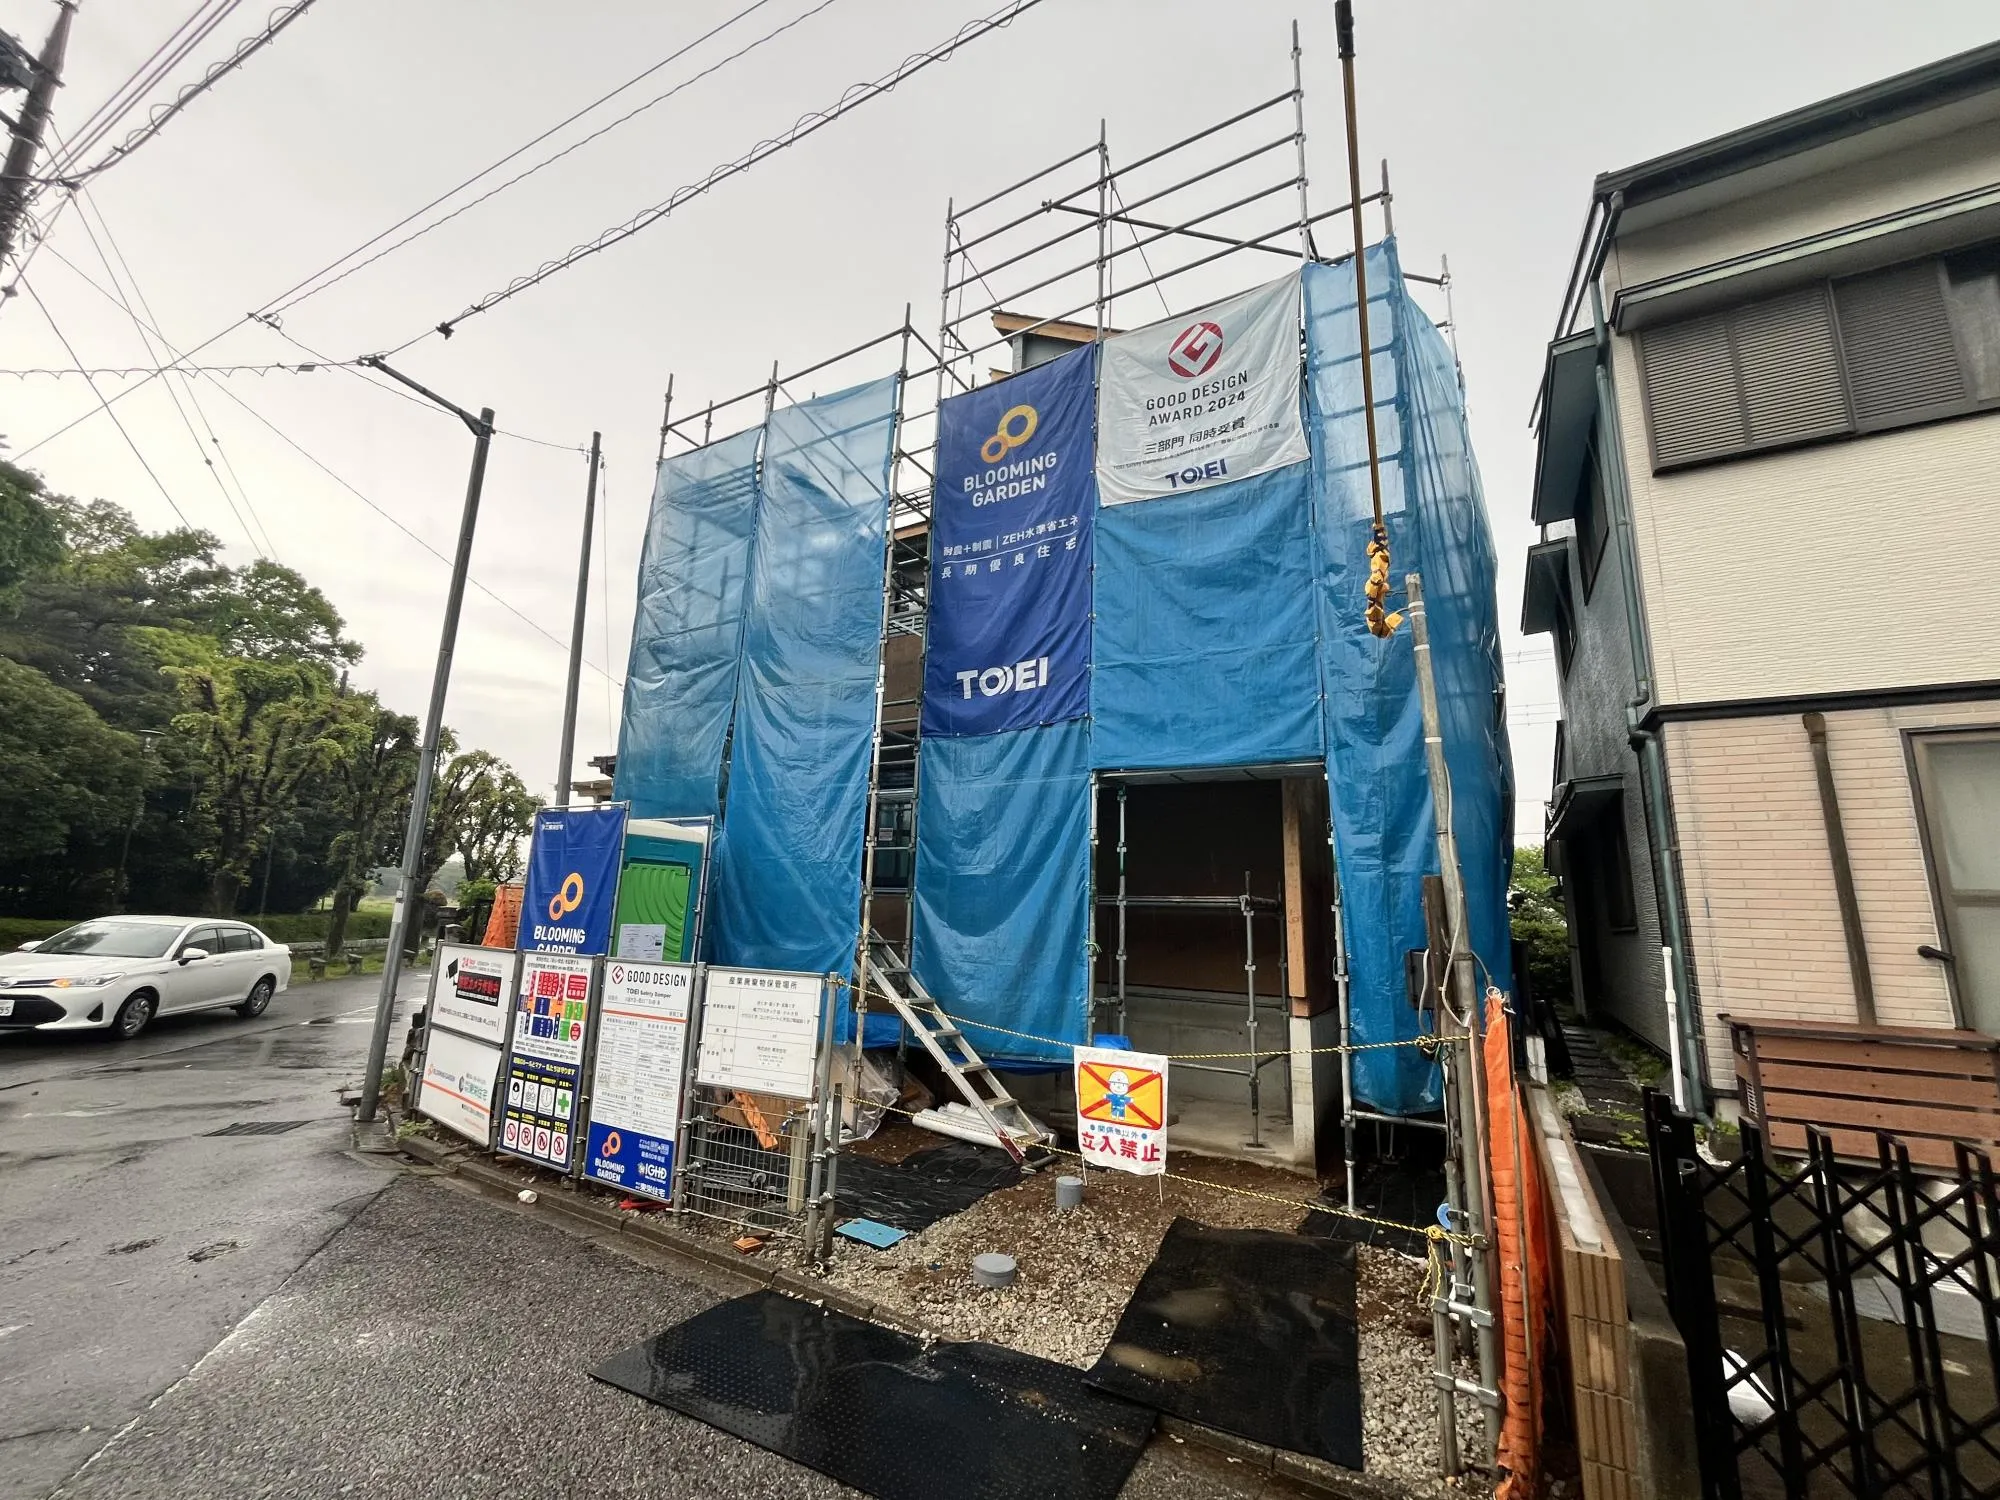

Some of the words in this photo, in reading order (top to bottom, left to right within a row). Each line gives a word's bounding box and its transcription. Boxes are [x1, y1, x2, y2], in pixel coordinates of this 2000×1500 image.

[1146, 392, 1187, 411] GOOD
[1192, 370, 1248, 401] DESIGN
[1148, 405, 1203, 427] AWARD
[1208, 390, 1246, 413] 2024
[1144, 435, 1185, 455] 三部門
[1189, 416, 1246, 445] 同時受賞
[963, 452, 1057, 493] BLOOMING
[1165, 458, 1229, 489] TOEI
[972, 474, 1046, 507] GARDEN
[956, 656, 1049, 700] TOEI
[533, 925, 586, 944] BLOOMING
[627, 970, 651, 984] GOOD
[653, 972, 687, 987] DESIGN
[1081, 1131, 1161, 1163] 立入禁止
[594, 1157, 625, 1174] BLOOMING
[596, 1168, 621, 1183] GARDEN
